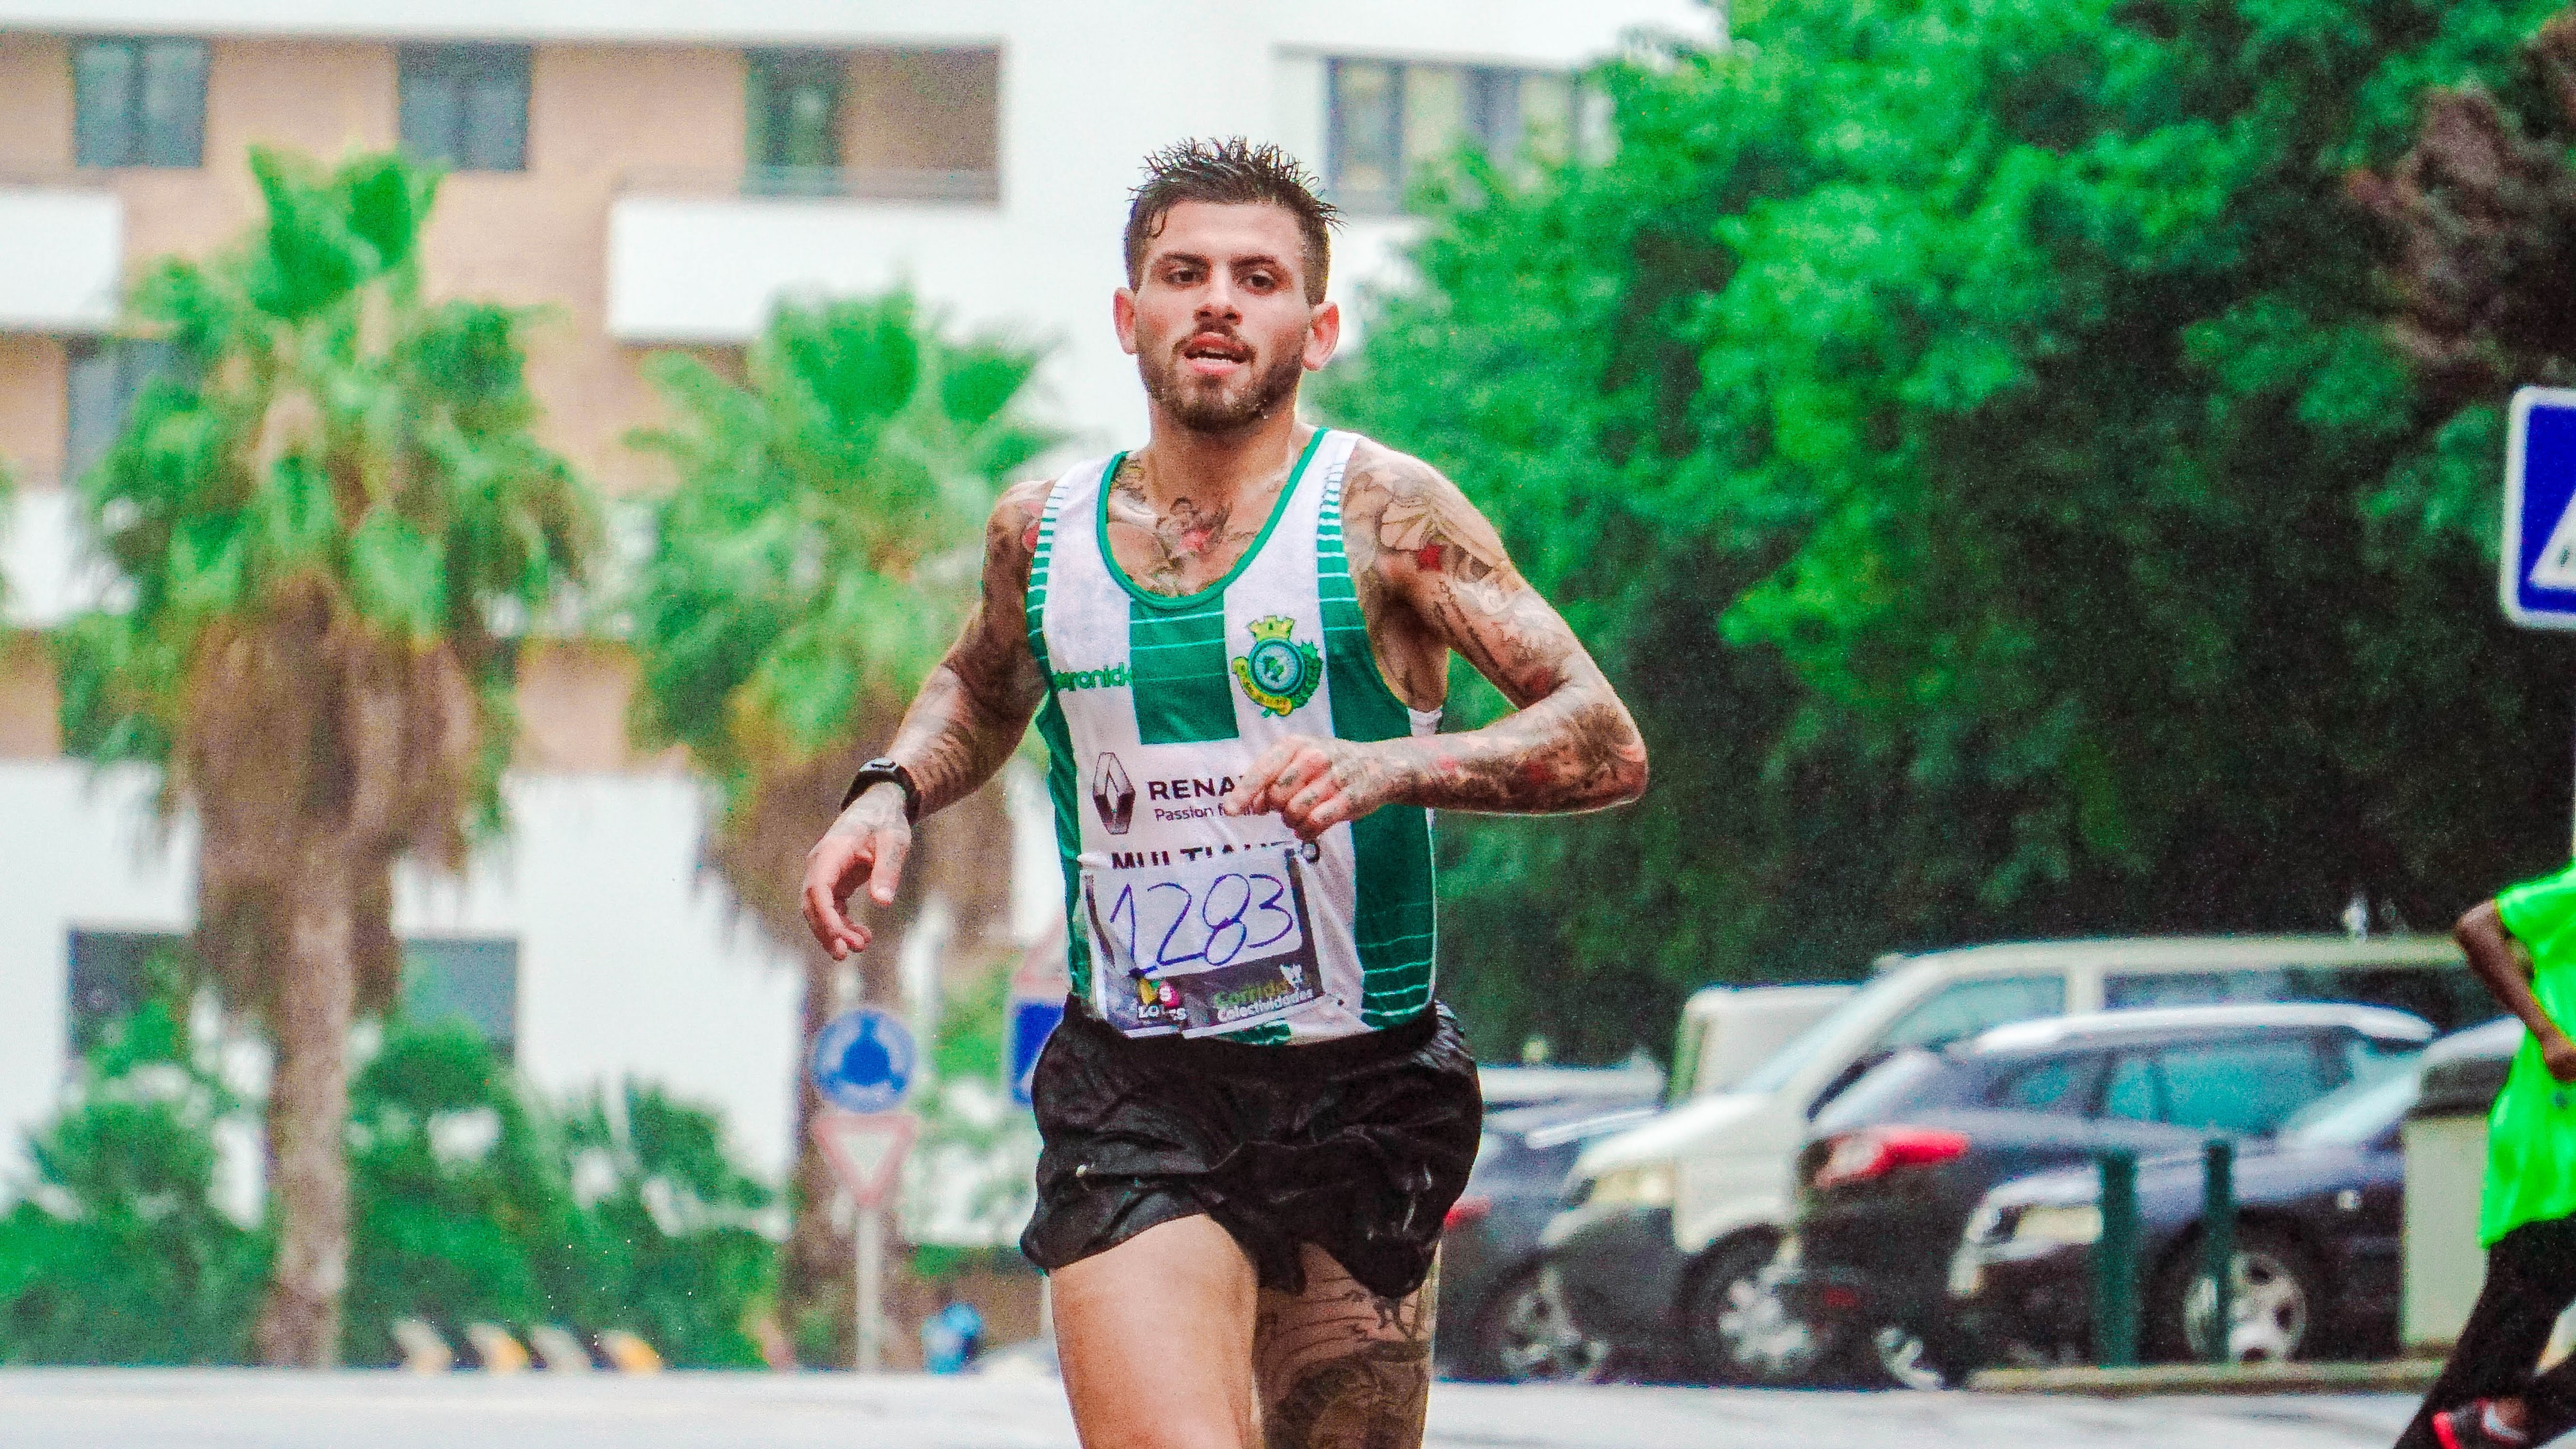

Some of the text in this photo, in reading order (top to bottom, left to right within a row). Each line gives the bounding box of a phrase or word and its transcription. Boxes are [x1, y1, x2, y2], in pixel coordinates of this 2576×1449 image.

[1148, 776, 1242, 800] RENA
[1154, 806, 1214, 821] Passion
[1110, 873, 1293, 972] 1283
